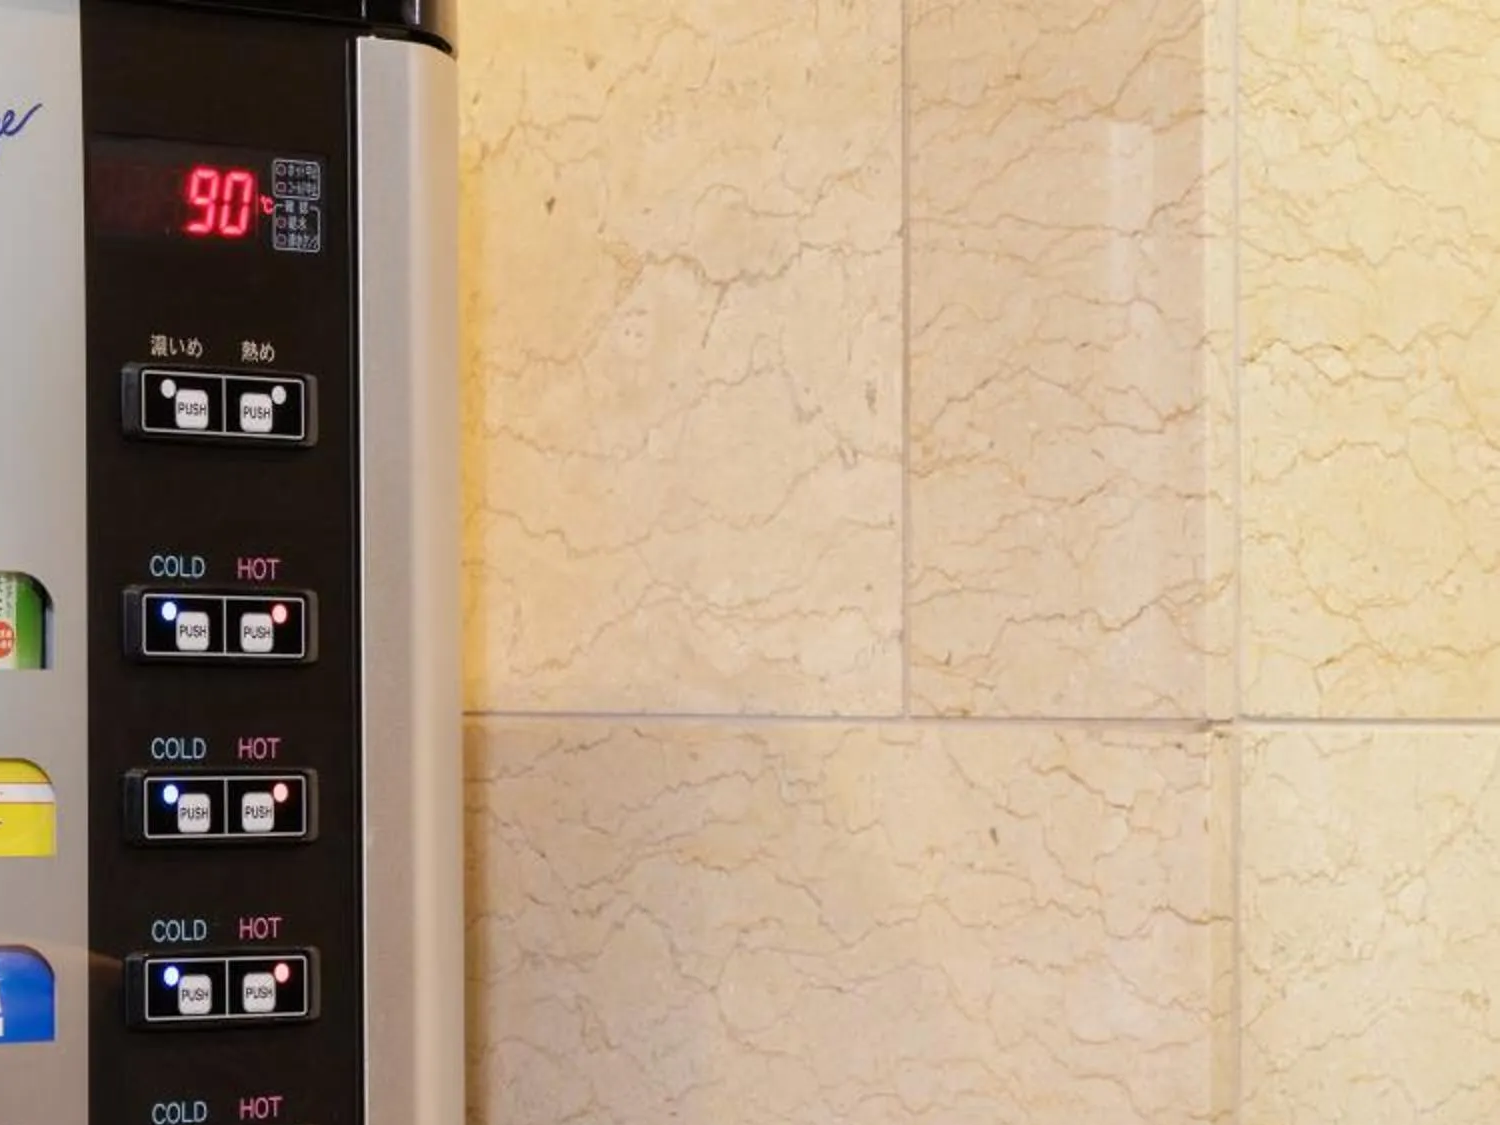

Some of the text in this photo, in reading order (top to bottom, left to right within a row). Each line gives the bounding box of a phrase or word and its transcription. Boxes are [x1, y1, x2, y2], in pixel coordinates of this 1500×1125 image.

[184, 166, 255, 237] 90
[151, 334, 203, 359] 濃いめ
[241, 340, 275, 363] 熱め
[177, 406, 207, 417] PUSH
[243, 406, 271, 420] PUSH
[150, 555, 206, 578] COLD
[237, 557, 281, 580] HOT
[179, 624, 207, 640] PUSH
[244, 625, 273, 640] PUSH
[151, 737, 206, 760] COLD
[238, 737, 281, 760] HOT
[180, 805, 209, 821] PUSH
[245, 805, 274, 820] PUSH
[152, 919, 207, 943] COLD
[239, 917, 282, 940] HOT
[181, 987, 209, 1003] PUSH
[245, 985, 274, 1000] PUSH
[152, 1101, 207, 1125] COLD
[239, 1096, 282, 1120] HOT
